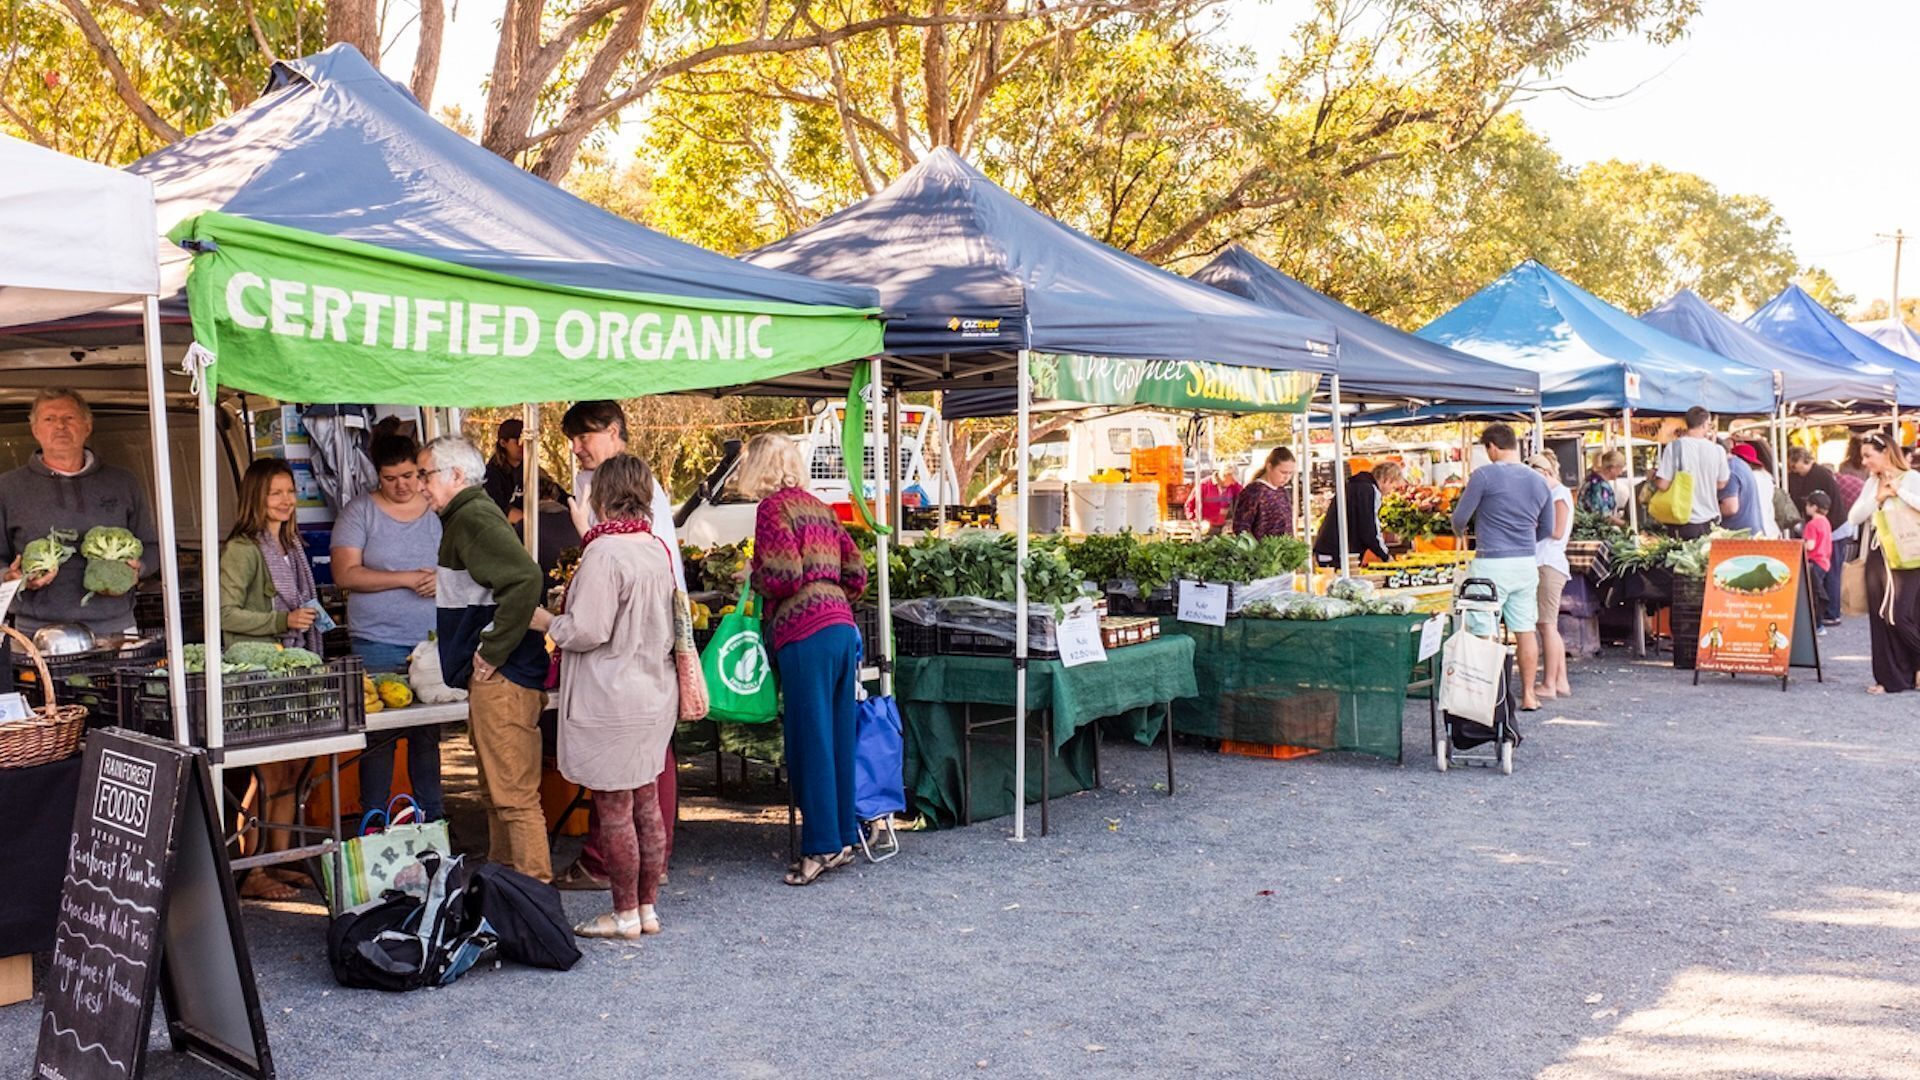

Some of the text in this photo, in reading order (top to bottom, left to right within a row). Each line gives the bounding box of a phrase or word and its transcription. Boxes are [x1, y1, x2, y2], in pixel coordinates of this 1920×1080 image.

[226, 271, 774, 360] CERTIFIED ORGANIC
[1073, 355, 1114, 381] The
[1185, 359, 1252, 403] Salad
[103, 756, 151, 787] RAINFOREST
[99, 784, 146, 827] FOODS
[69, 832, 117, 880] Rainforest
[119, 852, 144, 884] Plum
[110, 907, 129, 940] Nut
